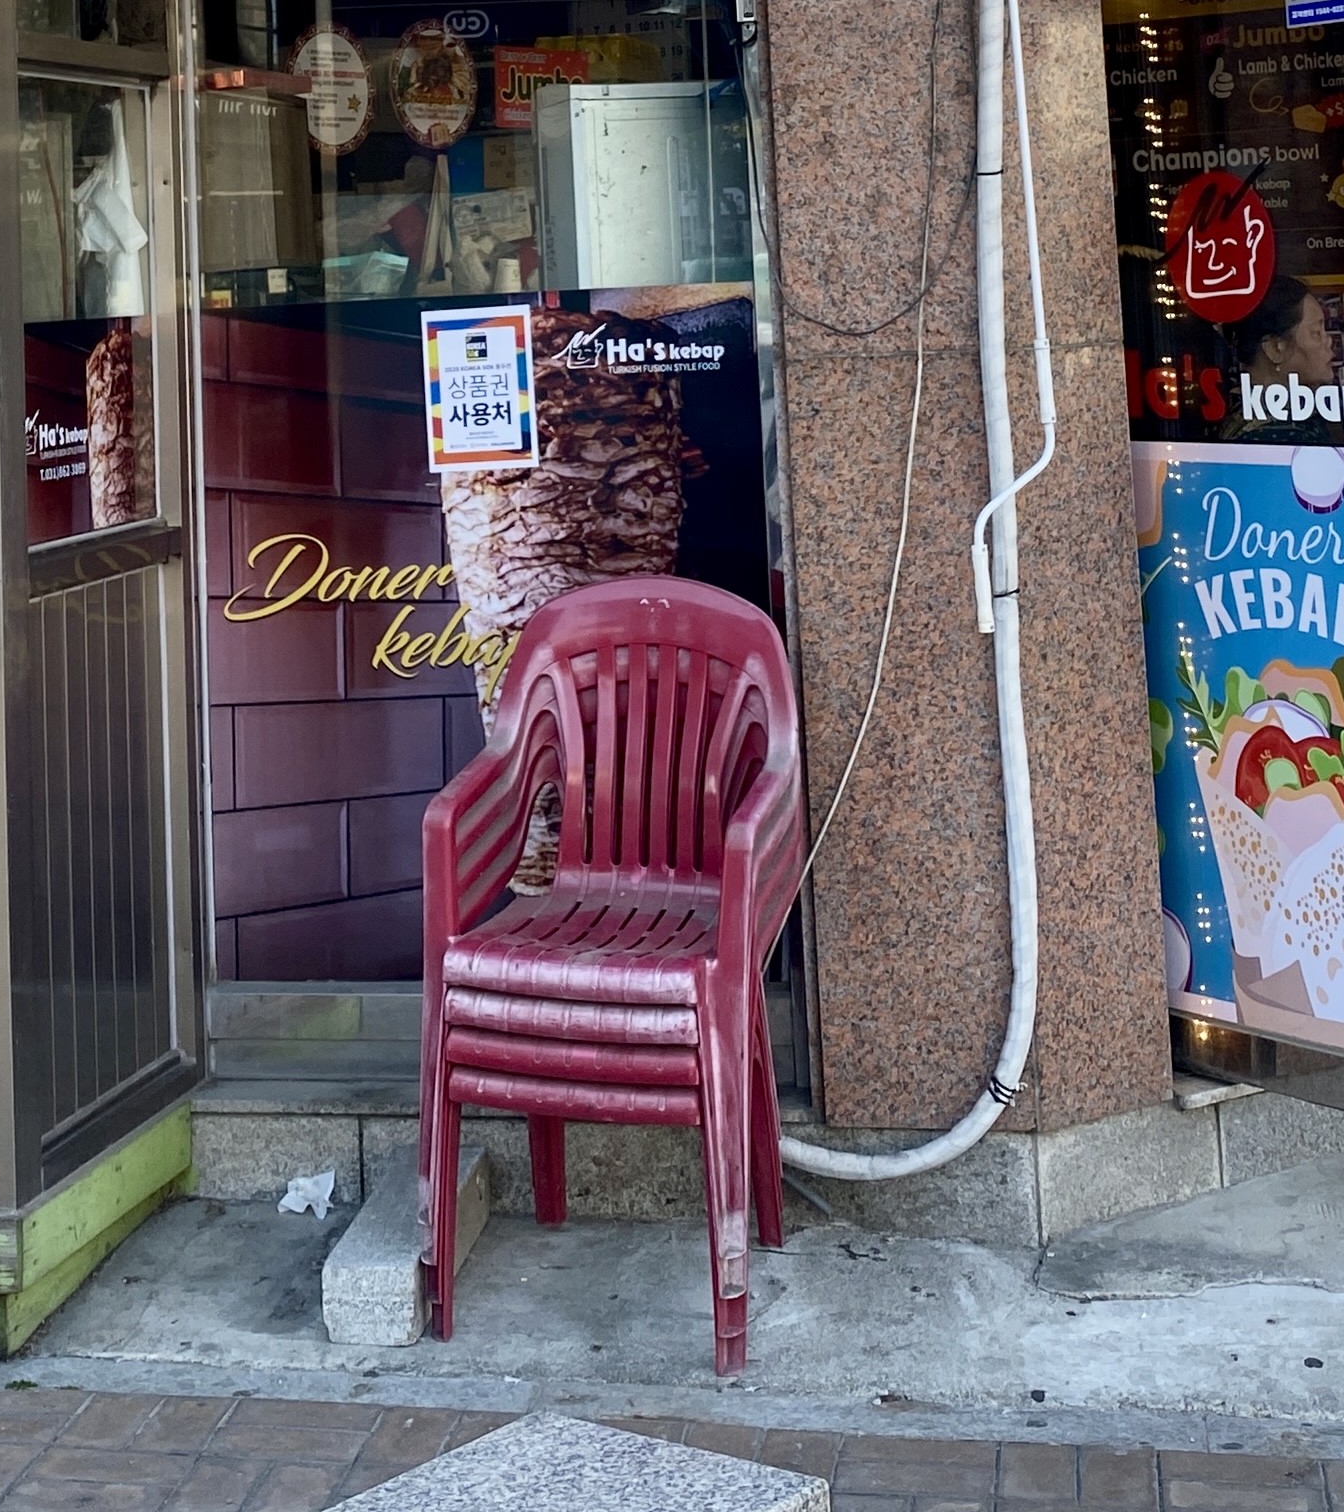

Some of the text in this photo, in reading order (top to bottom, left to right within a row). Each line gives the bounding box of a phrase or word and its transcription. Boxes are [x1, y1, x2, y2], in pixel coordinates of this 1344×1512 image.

[1132, 143, 1319, 175] Champions bowl
[607, 338, 725, 365] Ha's kebap
[643, 363, 672, 373] FUSION
[698, 361, 721, 370] FOOD
[448, 372, 510, 399] 상품권
[449, 400, 512, 428] 사용처
[223, 532, 457, 622] Doner
